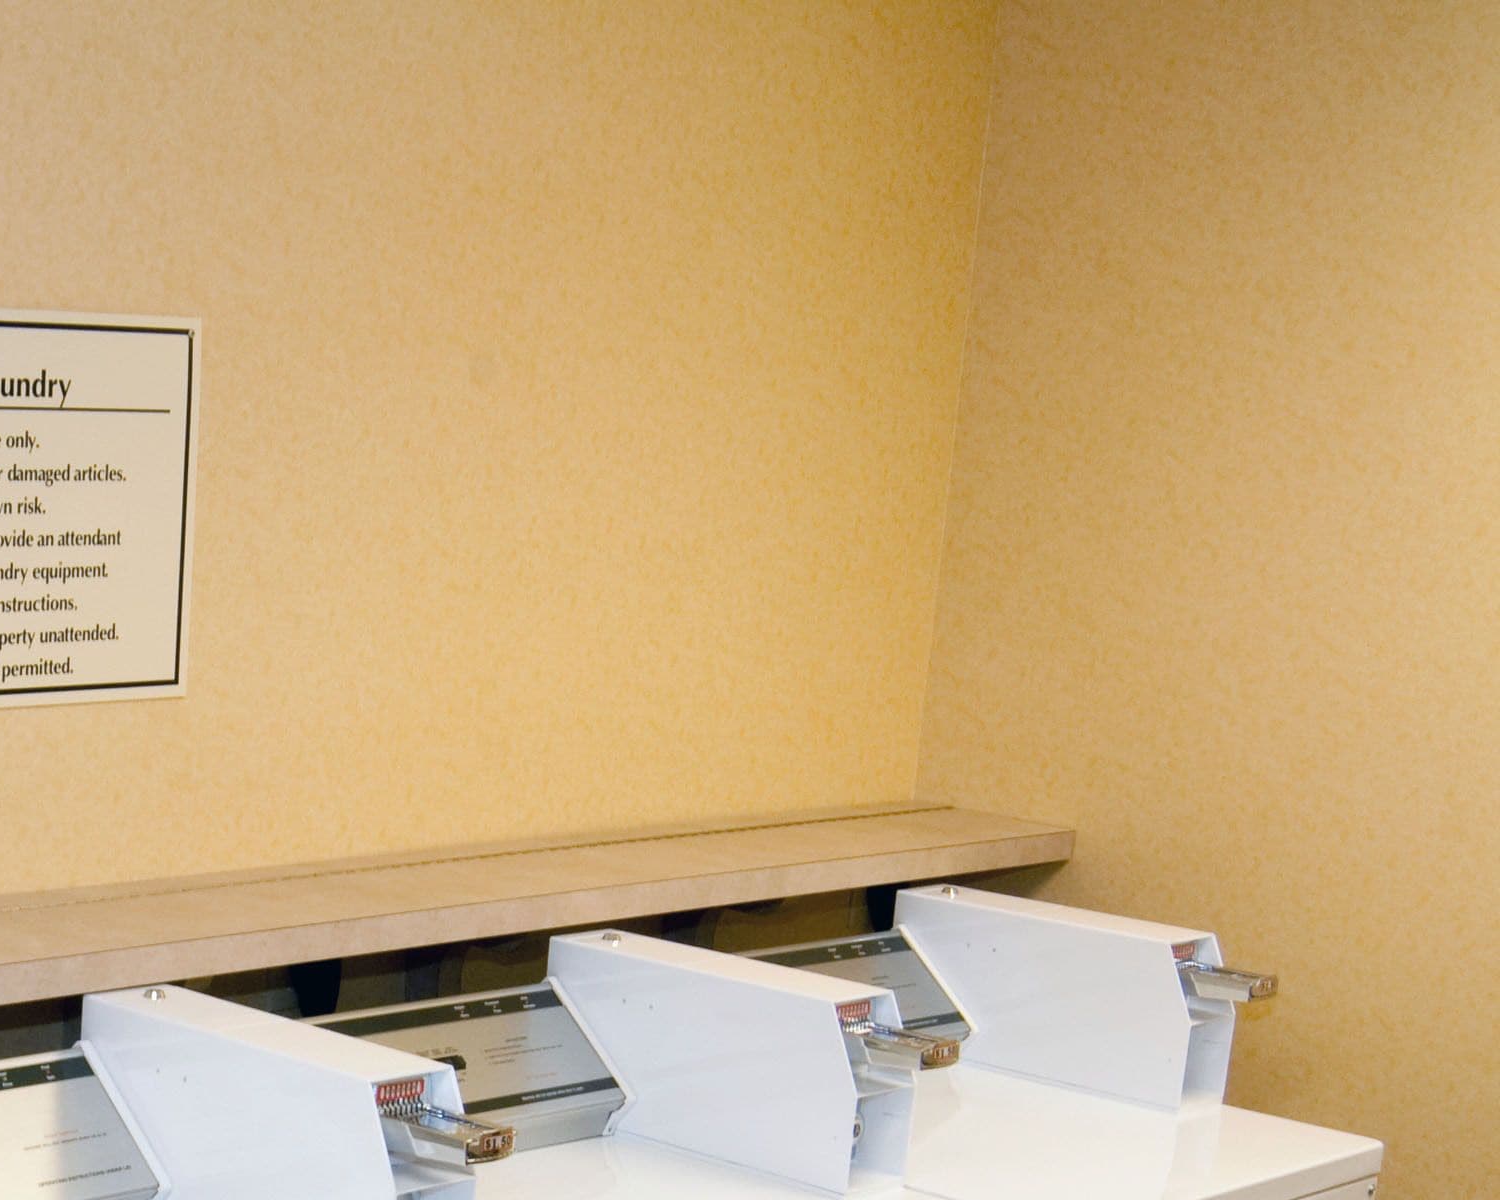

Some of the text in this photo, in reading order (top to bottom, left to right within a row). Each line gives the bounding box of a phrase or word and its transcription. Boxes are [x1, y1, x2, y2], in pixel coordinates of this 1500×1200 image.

[6, 430, 40, 453] only.
[7, 463, 70, 487] damaged
[73, 464, 126, 482] articles.
[17, 496, 46, 514] risk.
[37, 534, 54, 547] an
[57, 528, 121, 546] attendant
[32, 562, 108, 584] equipment.
[40, 623, 119, 643] unattended.
[2, 656, 73, 683] permitted.
[484, 1135, 513, 1151] $1.50
